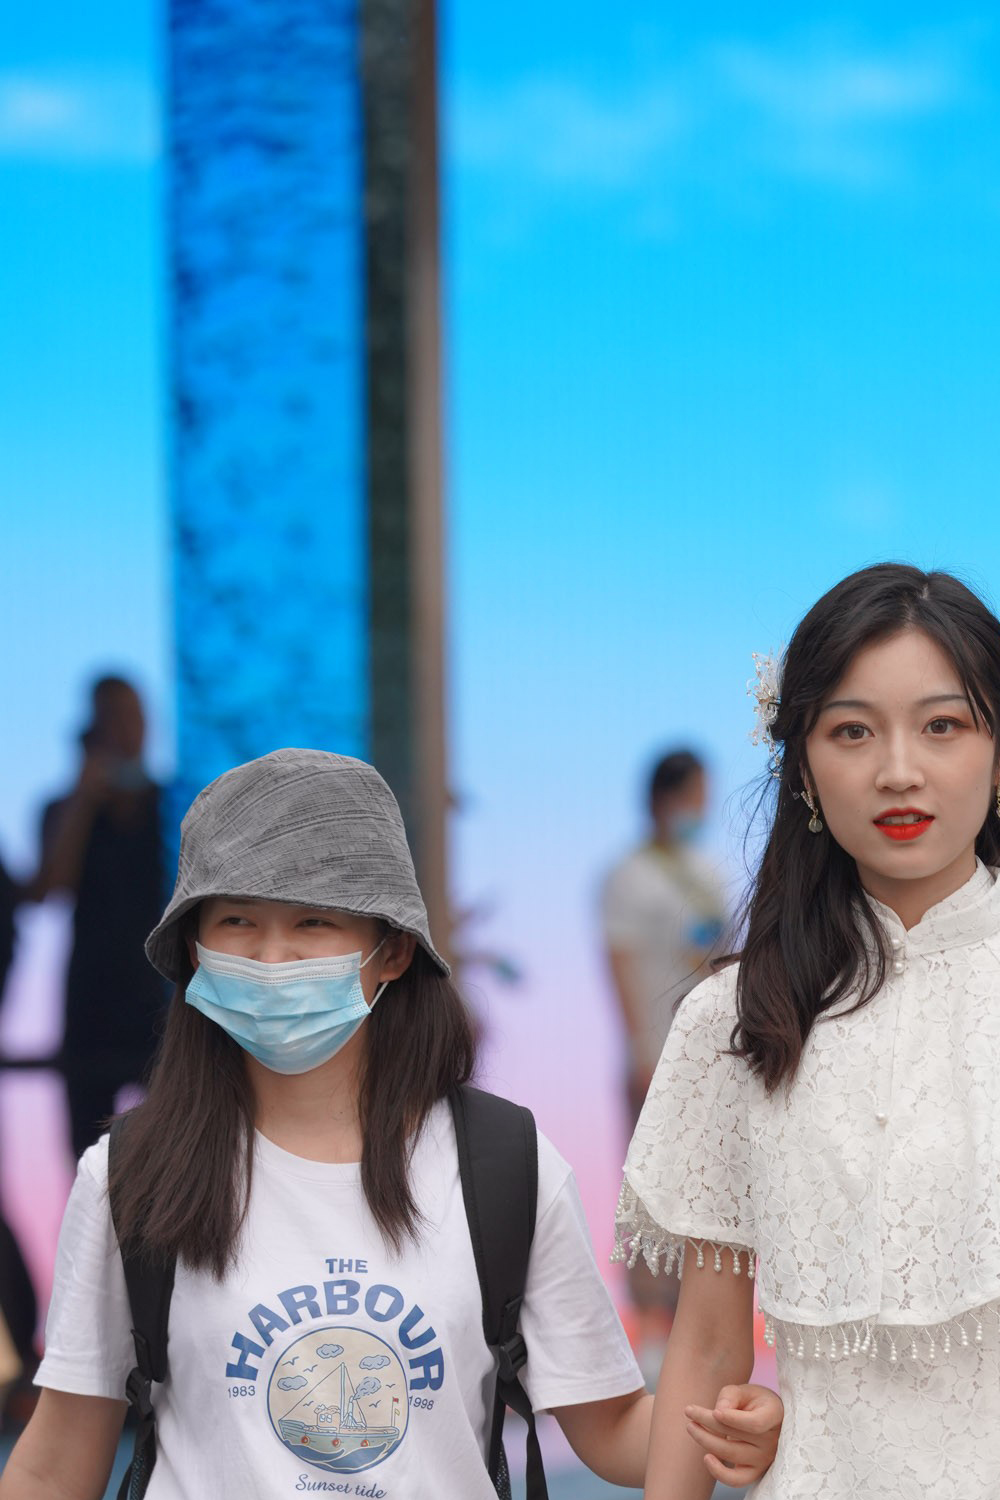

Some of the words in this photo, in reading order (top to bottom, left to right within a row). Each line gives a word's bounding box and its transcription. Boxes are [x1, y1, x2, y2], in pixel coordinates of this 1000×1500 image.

[325, 1258, 369, 1274] THE
[225, 1279, 445, 1391] HARBOUR
[227, 1385, 256, 1398] 1983
[408, 1396, 435, 1411] 1998
[295, 1473, 353, 1495] Sunset
[354, 1483, 387, 1499] tide
